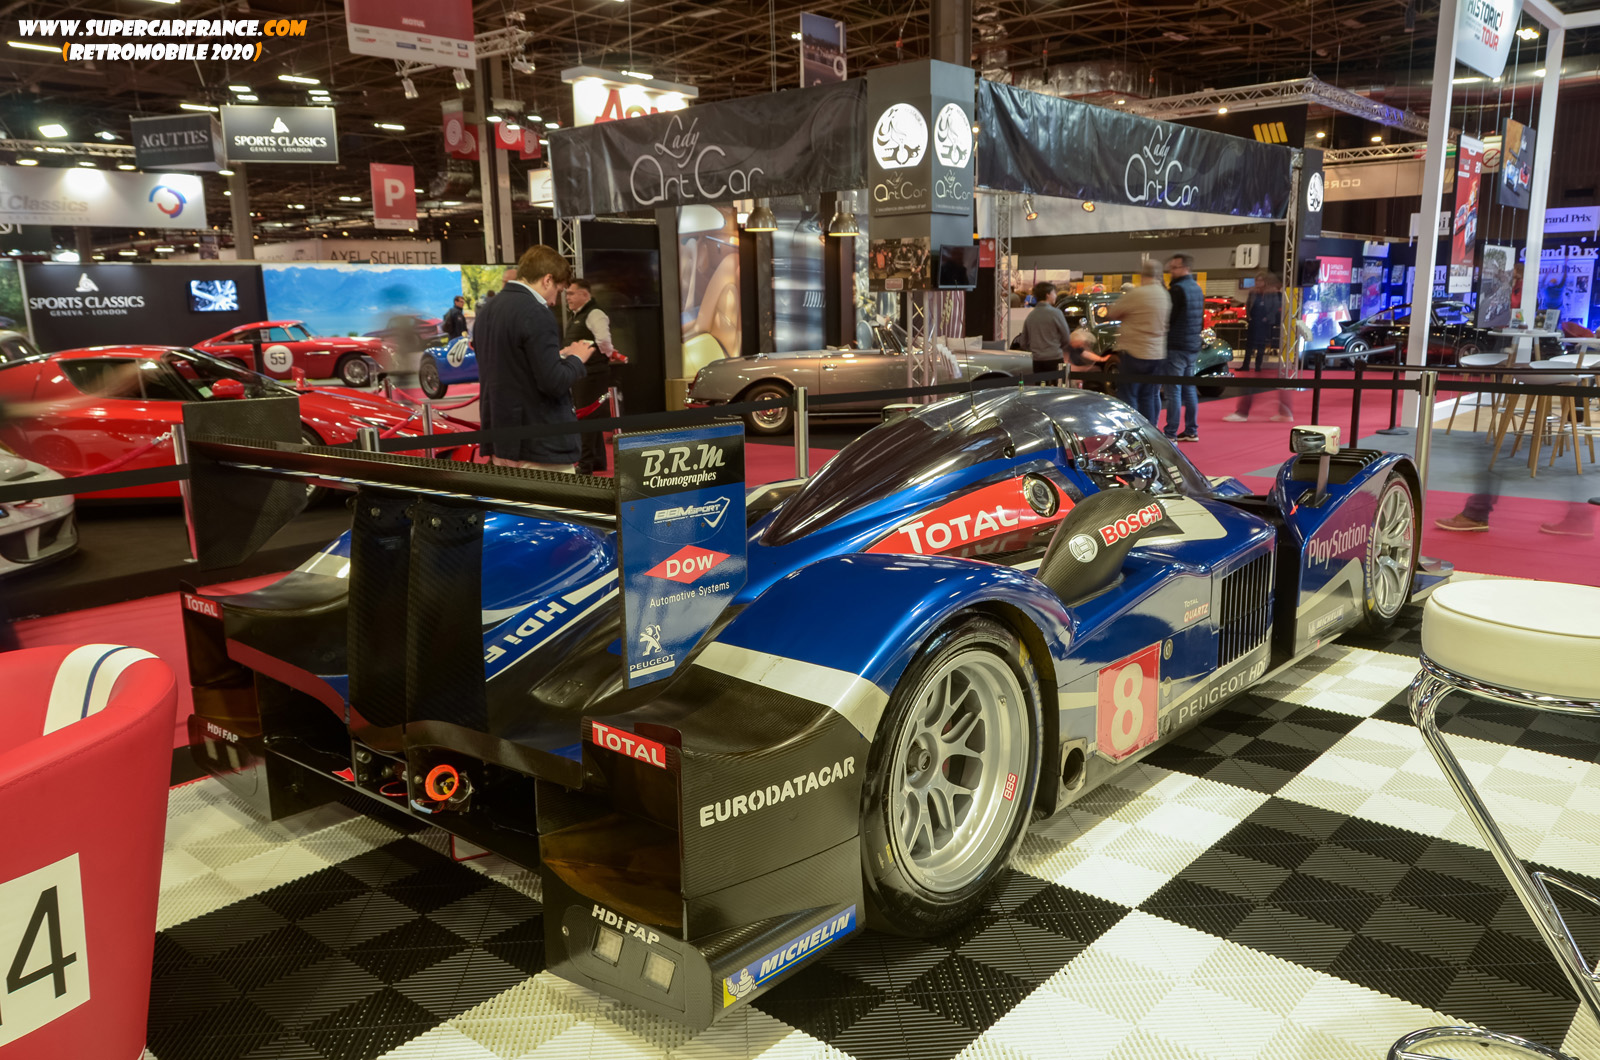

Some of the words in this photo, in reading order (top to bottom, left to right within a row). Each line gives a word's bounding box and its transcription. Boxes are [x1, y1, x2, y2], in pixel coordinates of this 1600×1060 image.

[1481, 26, 1499, 51] TOUR
[140, 129, 209, 149] AGUTTES
[234, 135, 276, 146] SPORTS
[277, 136, 328, 148] CLASSICS
[654, 114, 700, 168] Lady
[1143, 125, 1172, 175] Lady
[8, 194, 89, 212] Classics
[383, 178, 406, 207] P
[1545, 214, 1569, 223] rand
[1571, 213, 1592, 223] Prix
[370, 251, 438, 264] SCHUETTE
[30, 297, 83, 310] SPORTS
[84, 295, 145, 309] CLASSICS
[269, 352, 287, 366] 59
[449, 338, 468, 364] 40
[649, 470, 717, 489] Chronographes
[898, 505, 1019, 554] TOTAL
[1099, 502, 1163, 547] BOSCH
[1307, 522, 1367, 570] PlayStation
[1366, 526, 1375, 588] MICHELIN
[666, 554, 714, 578] DOW
[184, 594, 219, 618] TOTAL
[649, 589, 696, 609] Automotive
[698, 581, 730, 597] Systems
[1184, 603, 1209, 623] QUARTZ
[629, 654, 676, 672] PEUGEOT
[1179, 670, 1247, 724] PEUGEOT
[1248, 658, 1267, 682] HDi
[1111, 662, 1144, 751] 8
[207, 722, 222, 737] HDi
[222, 728, 239, 743] FAP
[592, 723, 666, 768] TOTAL
[700, 756, 855, 828] EURODATACAR
[1003, 774, 1018, 800] BBS
[591, 904, 624, 930] HDi
[624, 922, 660, 945] FAP
[759, 912, 850, 978] MICHELIN
